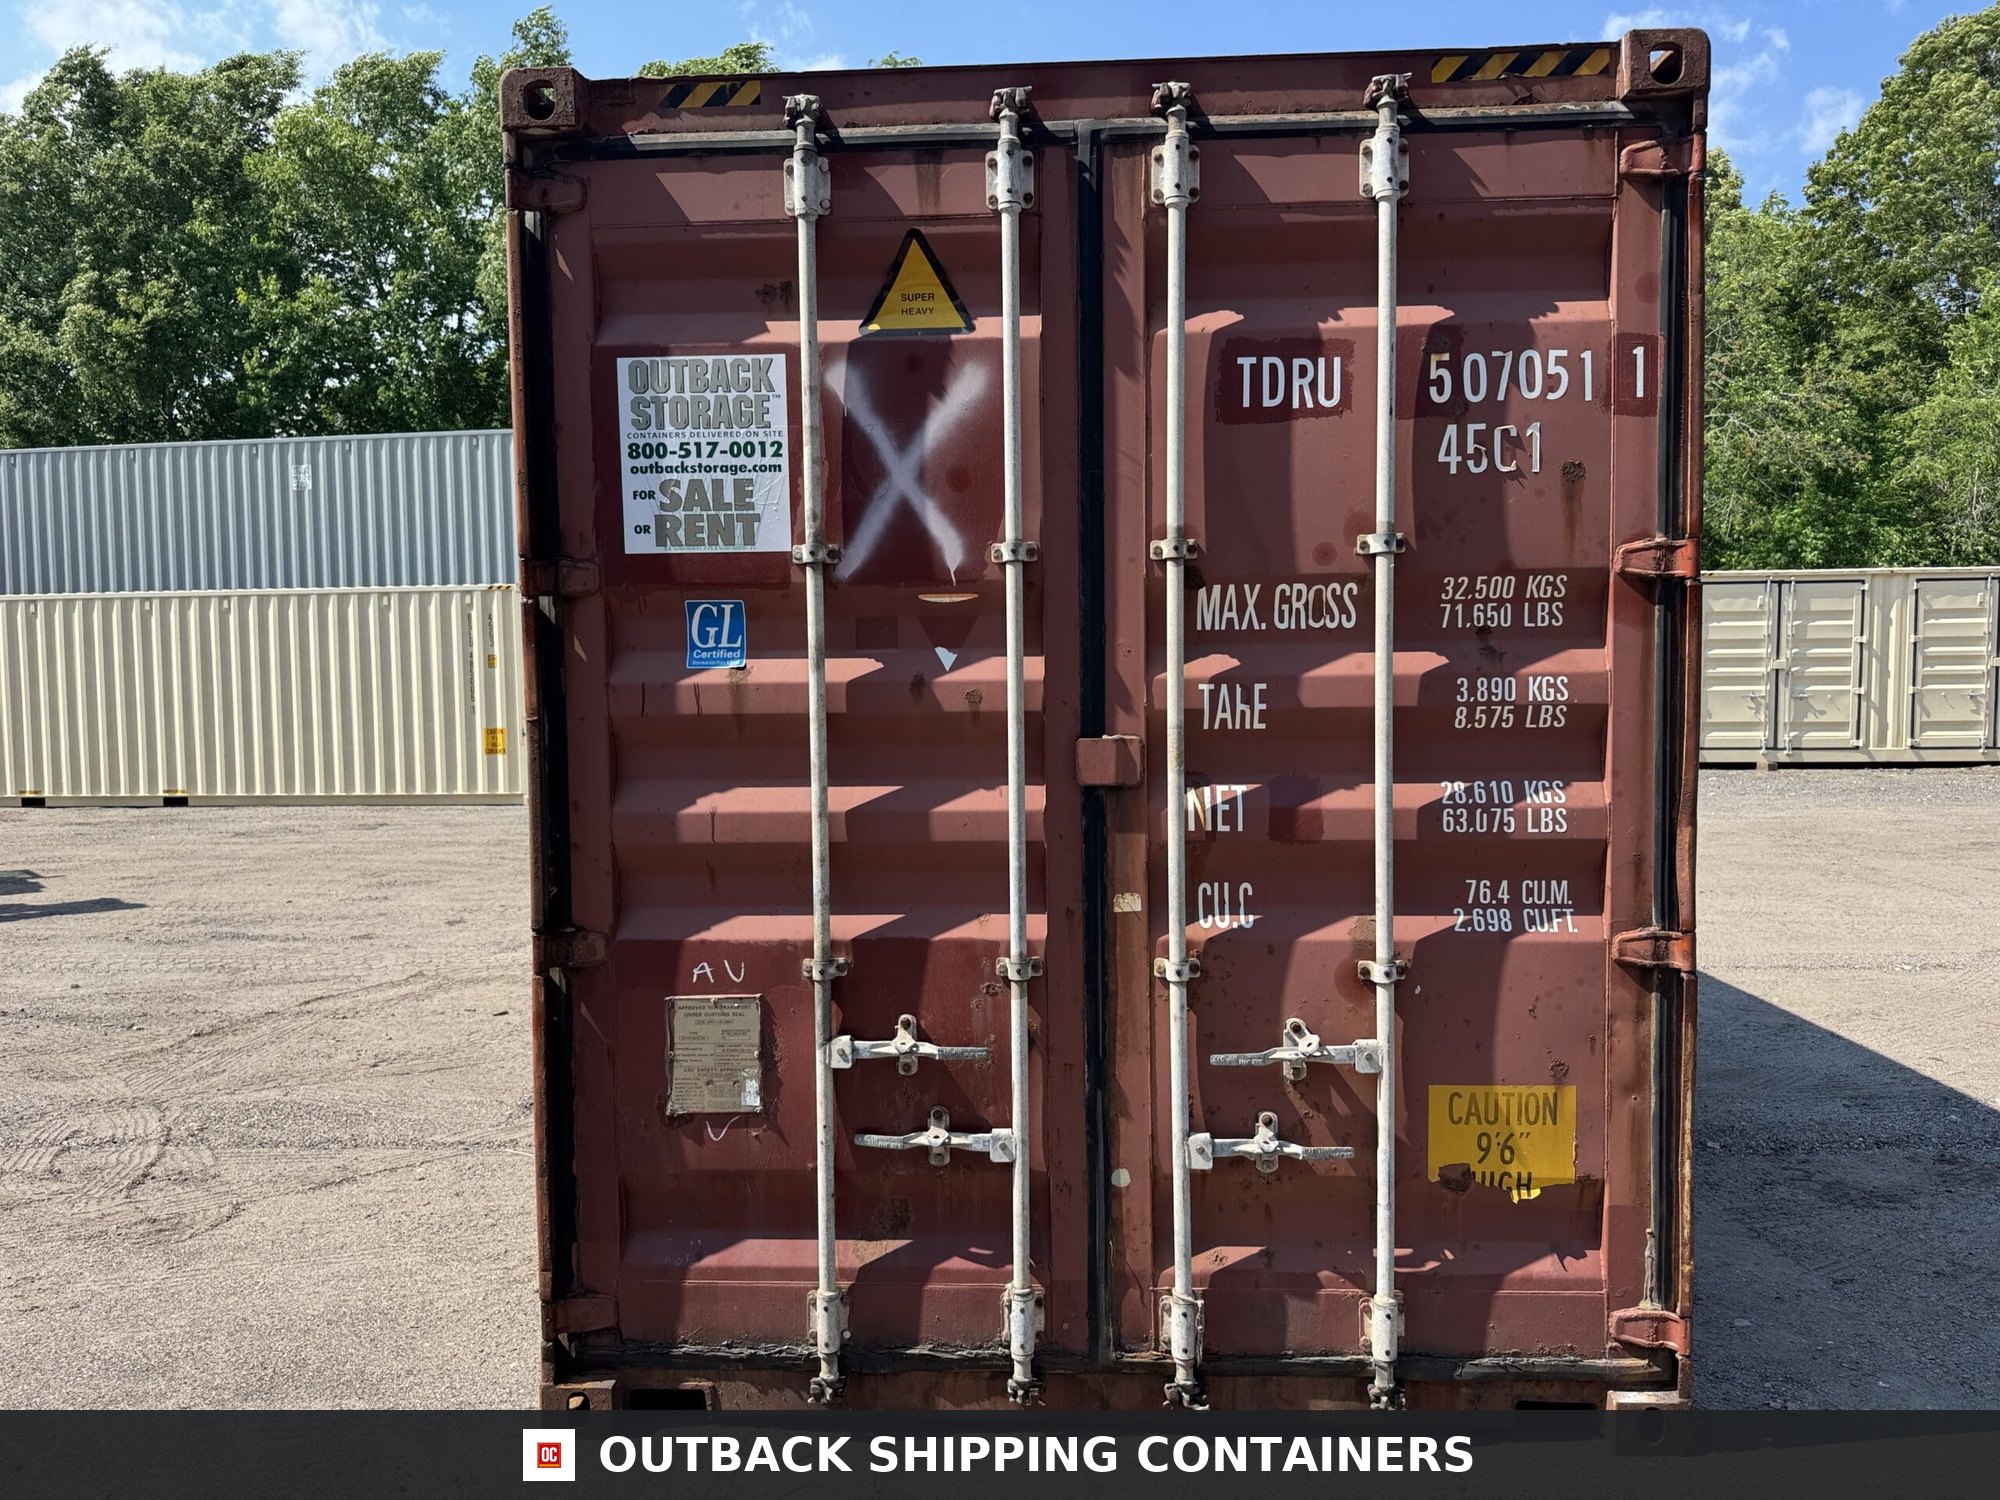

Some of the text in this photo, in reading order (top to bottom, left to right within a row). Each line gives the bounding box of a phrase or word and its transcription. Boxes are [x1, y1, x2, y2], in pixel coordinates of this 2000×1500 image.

[900, 293, 935, 302] SUPER
[901, 308, 934, 316] HEAVY
[627, 358, 775, 394] OUTBACK
[1237, 346, 1644, 408] TDRU 507051 1
[630, 394, 771, 430] STORAGE
[745, 430, 759, 438] ON
[764, 430, 783, 438] SITE
[628, 440, 782, 459] 800-517-0012
[630, 461, 782, 475] outbackstorage.com
[633, 478, 755, 512] FOR SALE
[634, 514, 760, 547] OR RENT
[1441, 574, 1568, 600] 32,500 KGS
[1196, 582, 1358, 630] MAX. GROSS
[1440, 602, 1564, 628] 71,650 LBS
[692, 604, 742, 648] GL
[694, 649, 740, 658] Certified
[1456, 676, 1568, 702] 3,890 KGS
[1454, 704, 1567, 729] 8,575 LBS
[1440, 780, 1566, 804] 28,610 KGS
[1186, 785, 1247, 832] NET
[1442, 808, 1568, 833] 63,075 LBS
[1465, 879, 1510, 904] 76.4
[1453, 908, 1512, 932] 2,698
[1448, 1092, 1558, 1126] CAUTION
